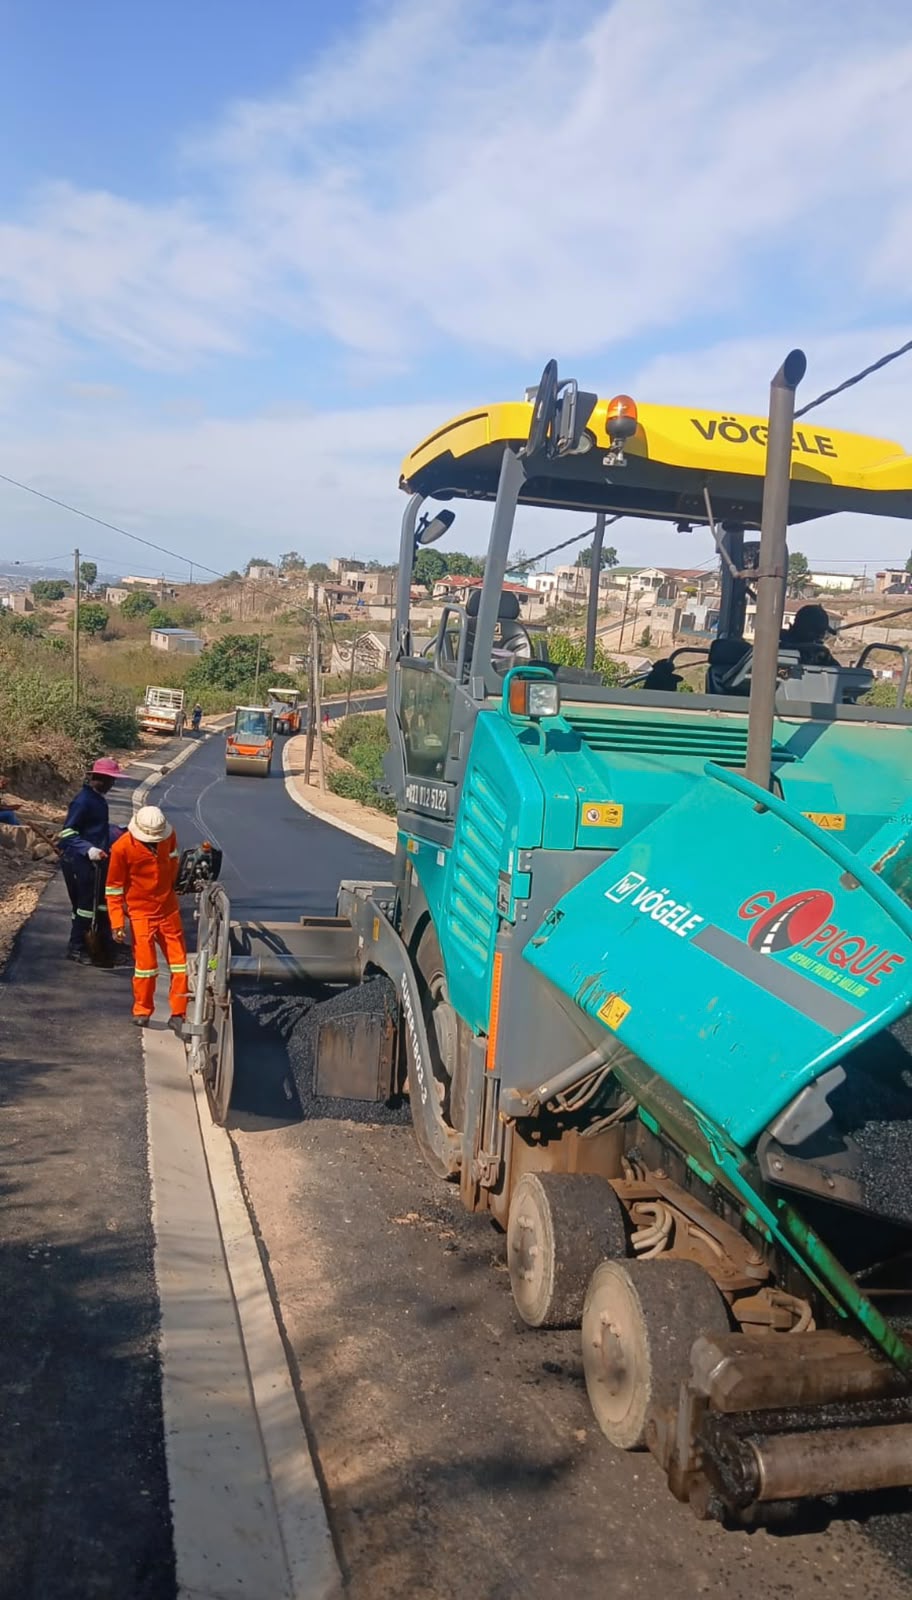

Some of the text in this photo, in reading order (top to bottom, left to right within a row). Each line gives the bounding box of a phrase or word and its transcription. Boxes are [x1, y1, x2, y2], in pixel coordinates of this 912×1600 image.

[431, 788, 447, 811] 5122
[631, 886, 704, 937] VÖGELE
[803, 924, 905, 985] PIQUE
[401, 972, 415, 1037] SUPER
